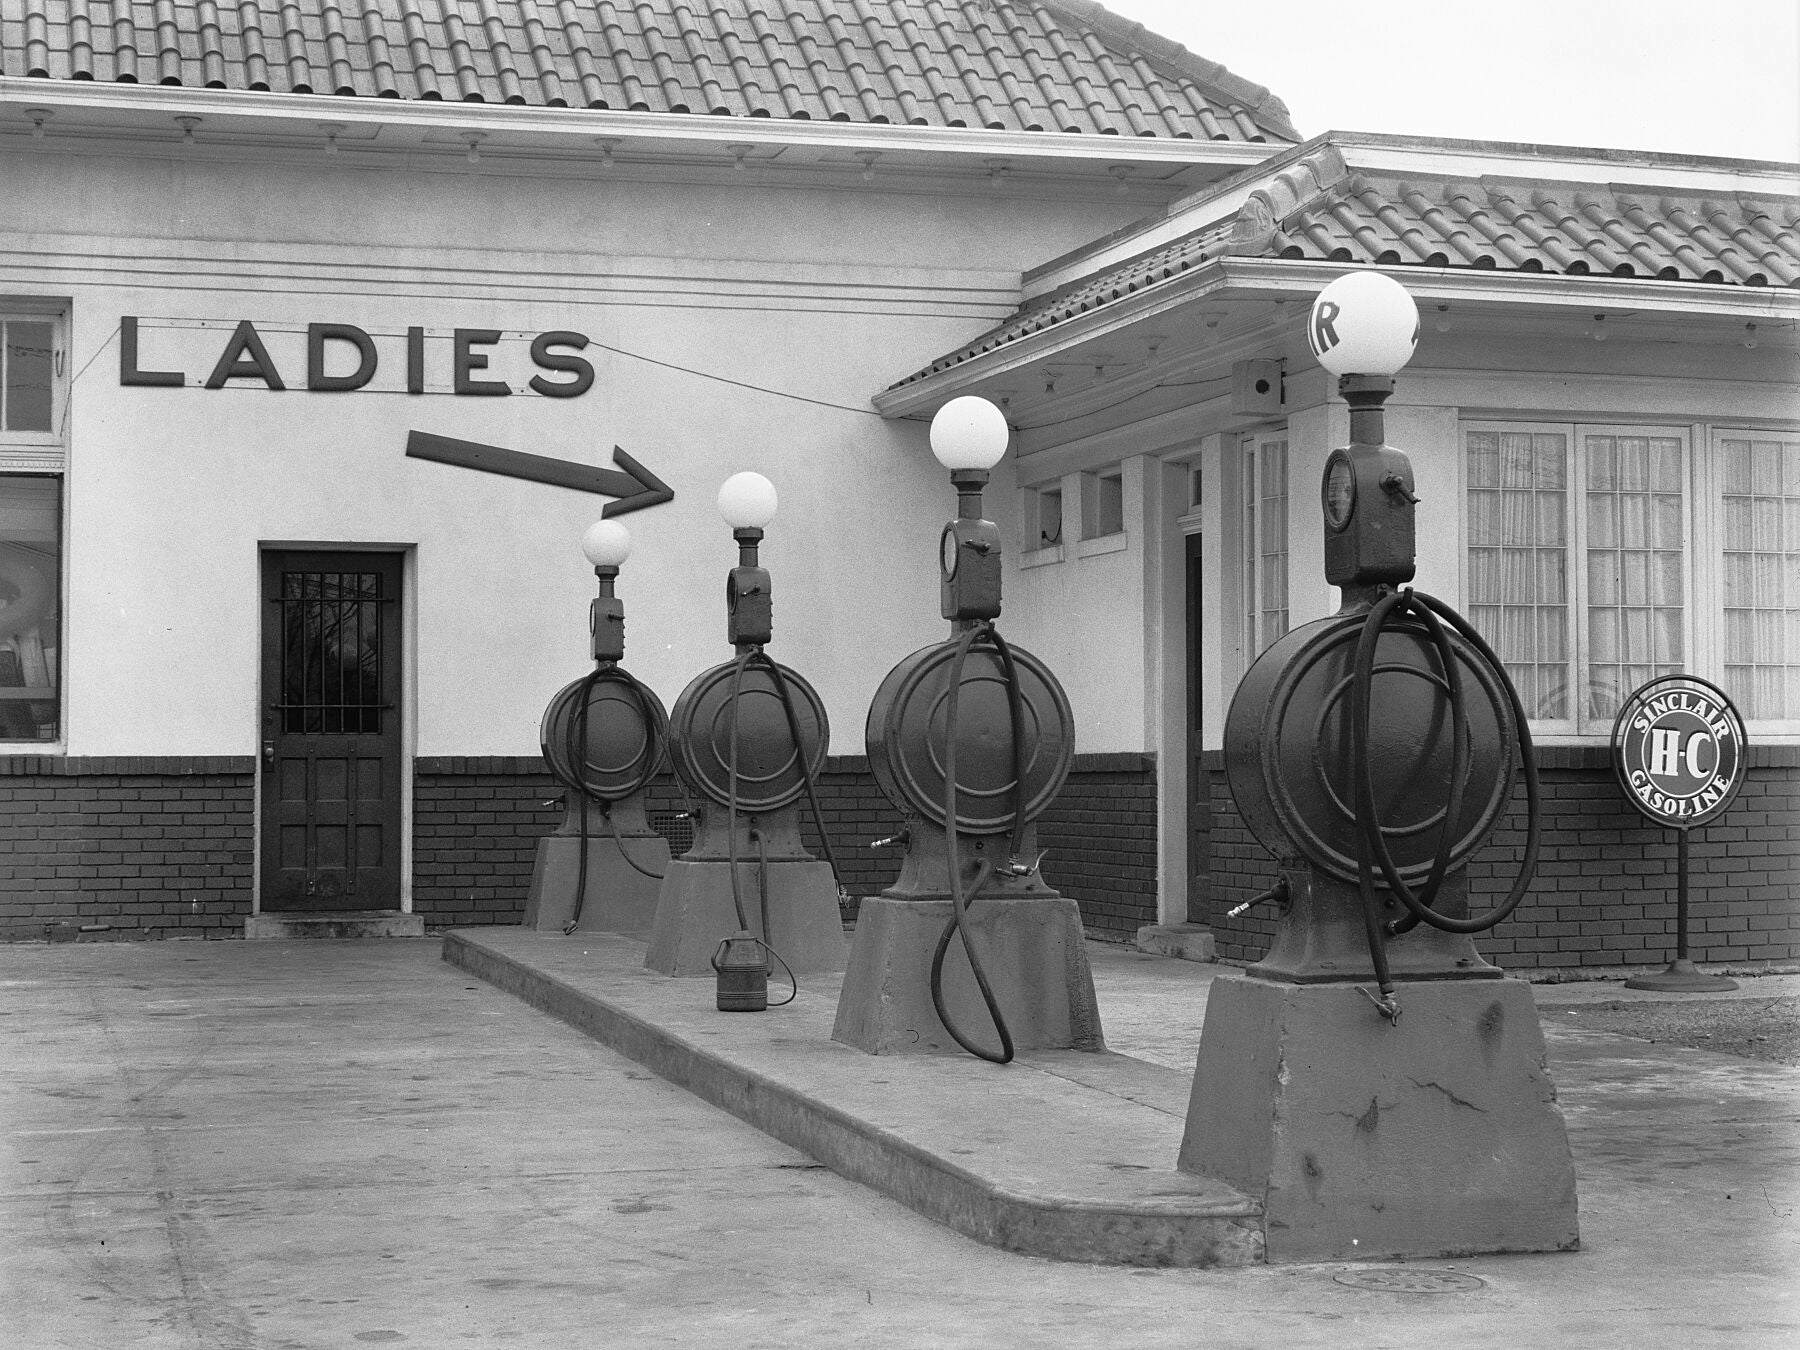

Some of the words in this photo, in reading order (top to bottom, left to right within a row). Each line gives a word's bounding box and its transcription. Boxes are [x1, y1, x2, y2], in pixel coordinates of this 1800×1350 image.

[120, 316, 595, 398] LADIES
[1633, 693, 1730, 740] SINCLAIR
[1650, 728, 1711, 778] H-C
[1631, 769, 1729, 816] GASOLINE
